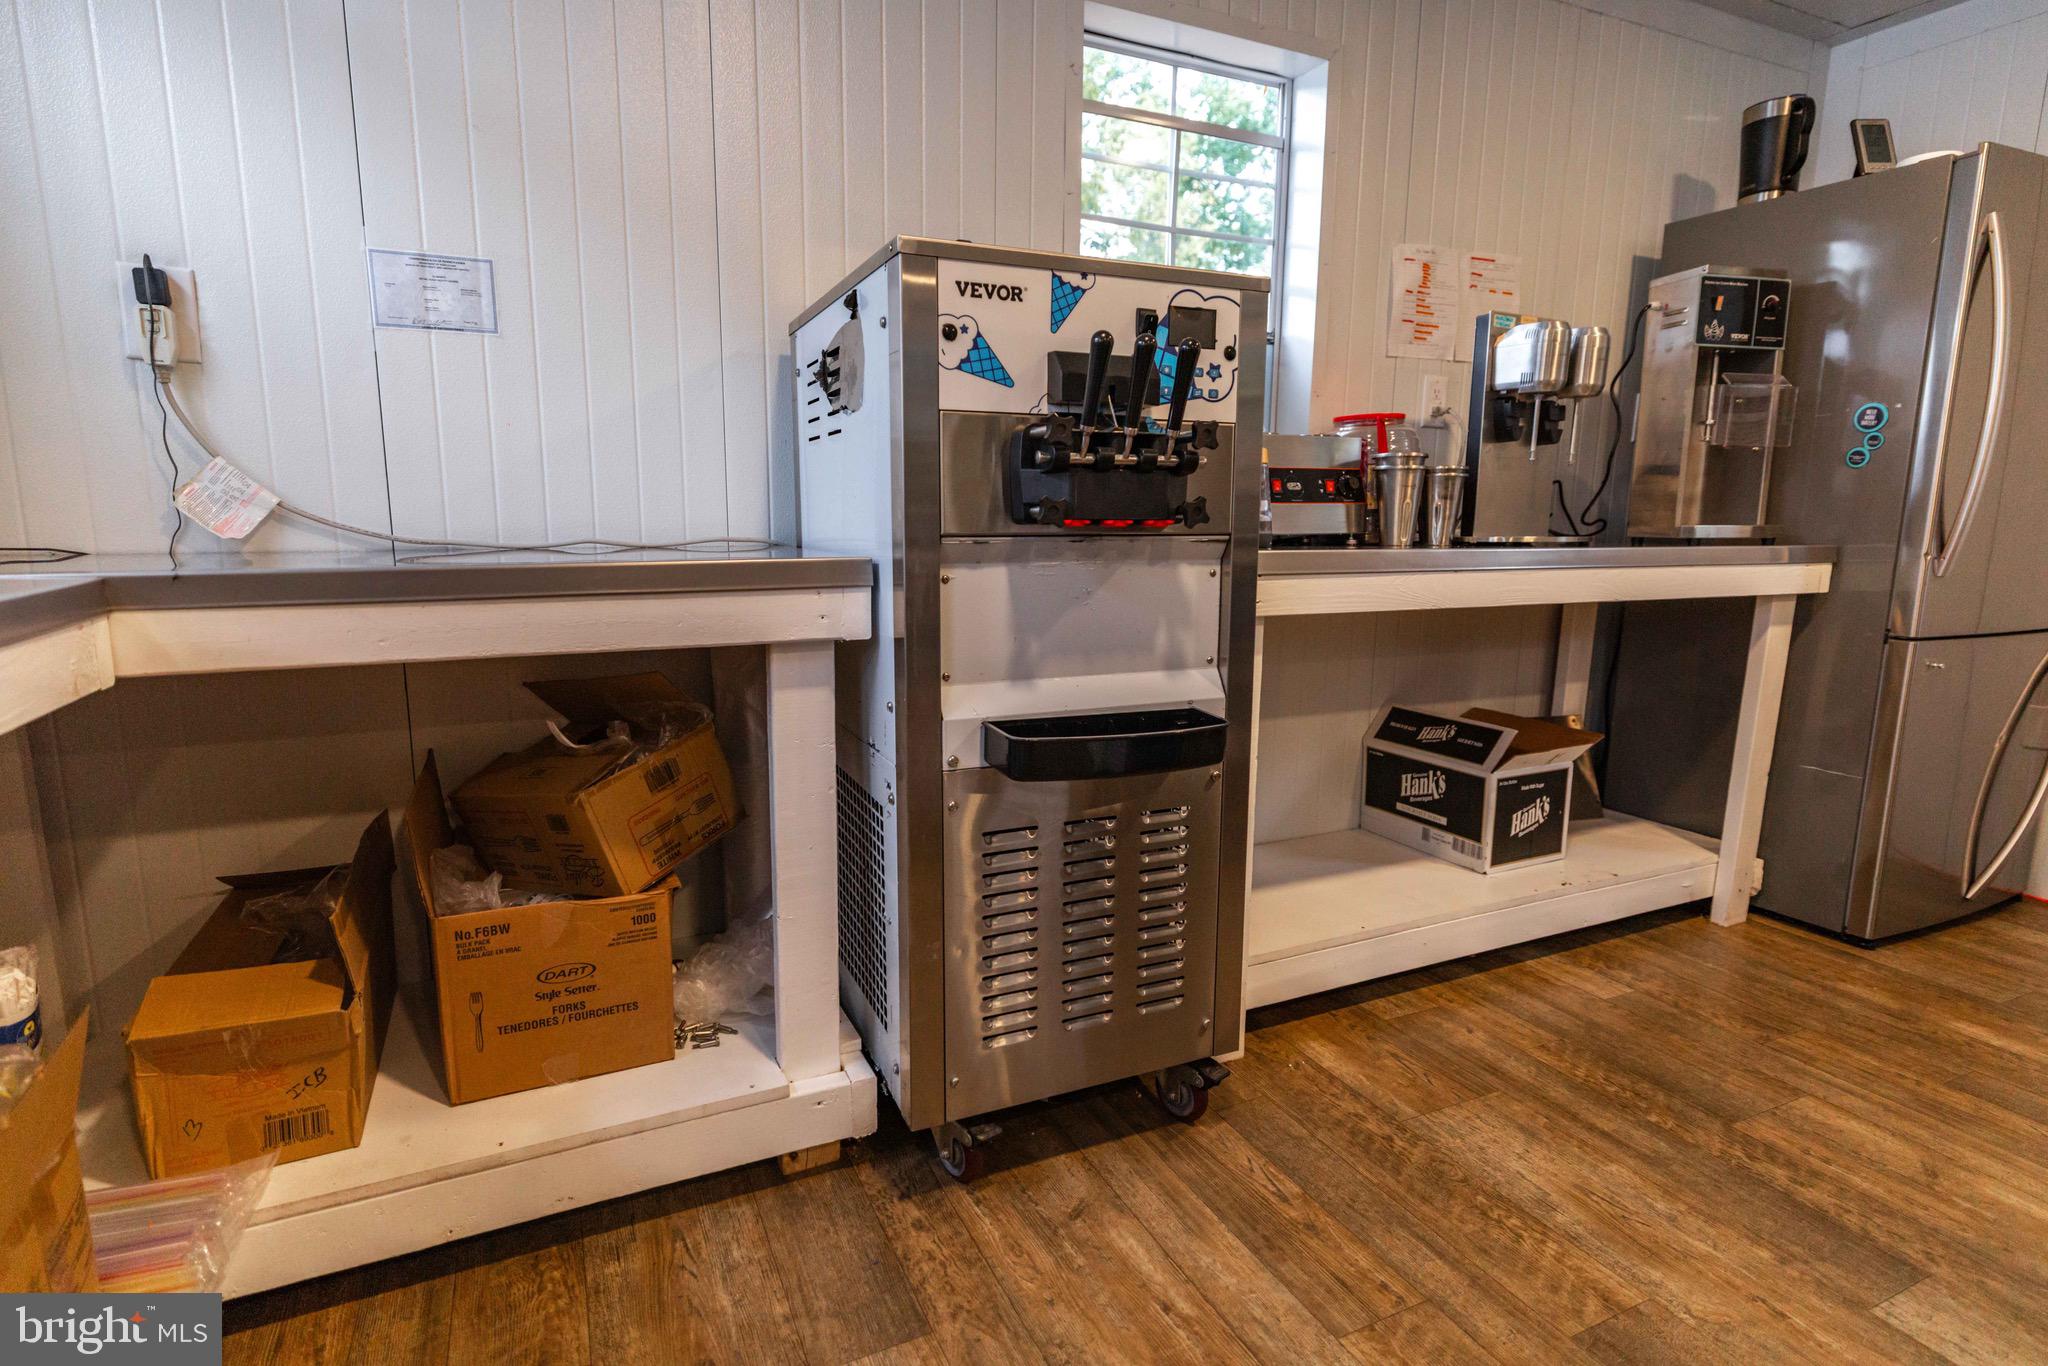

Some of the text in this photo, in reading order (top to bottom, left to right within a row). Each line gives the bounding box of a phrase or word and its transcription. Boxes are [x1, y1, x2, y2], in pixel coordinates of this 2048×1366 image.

[955, 280, 1023, 302] VEVOR
[1417, 724, 1457, 741] Hank's
[1400, 770, 1447, 800] Hank's
[1510, 795, 1550, 838] Hank's
[631, 912, 657, 926] 1000
[457, 950, 494, 961] EMBALLAGE
[544, 965, 588, 981] DART
[534, 989, 561, 1002] Style
[552, 1001, 586, 1015] FORKS
[497, 1015, 559, 1035] TENEDORES
[568, 1001, 639, 1023] FOURCHETTES
[264, 1112, 286, 1121] Made
[296, 1103, 326, 1113] Vietnam
